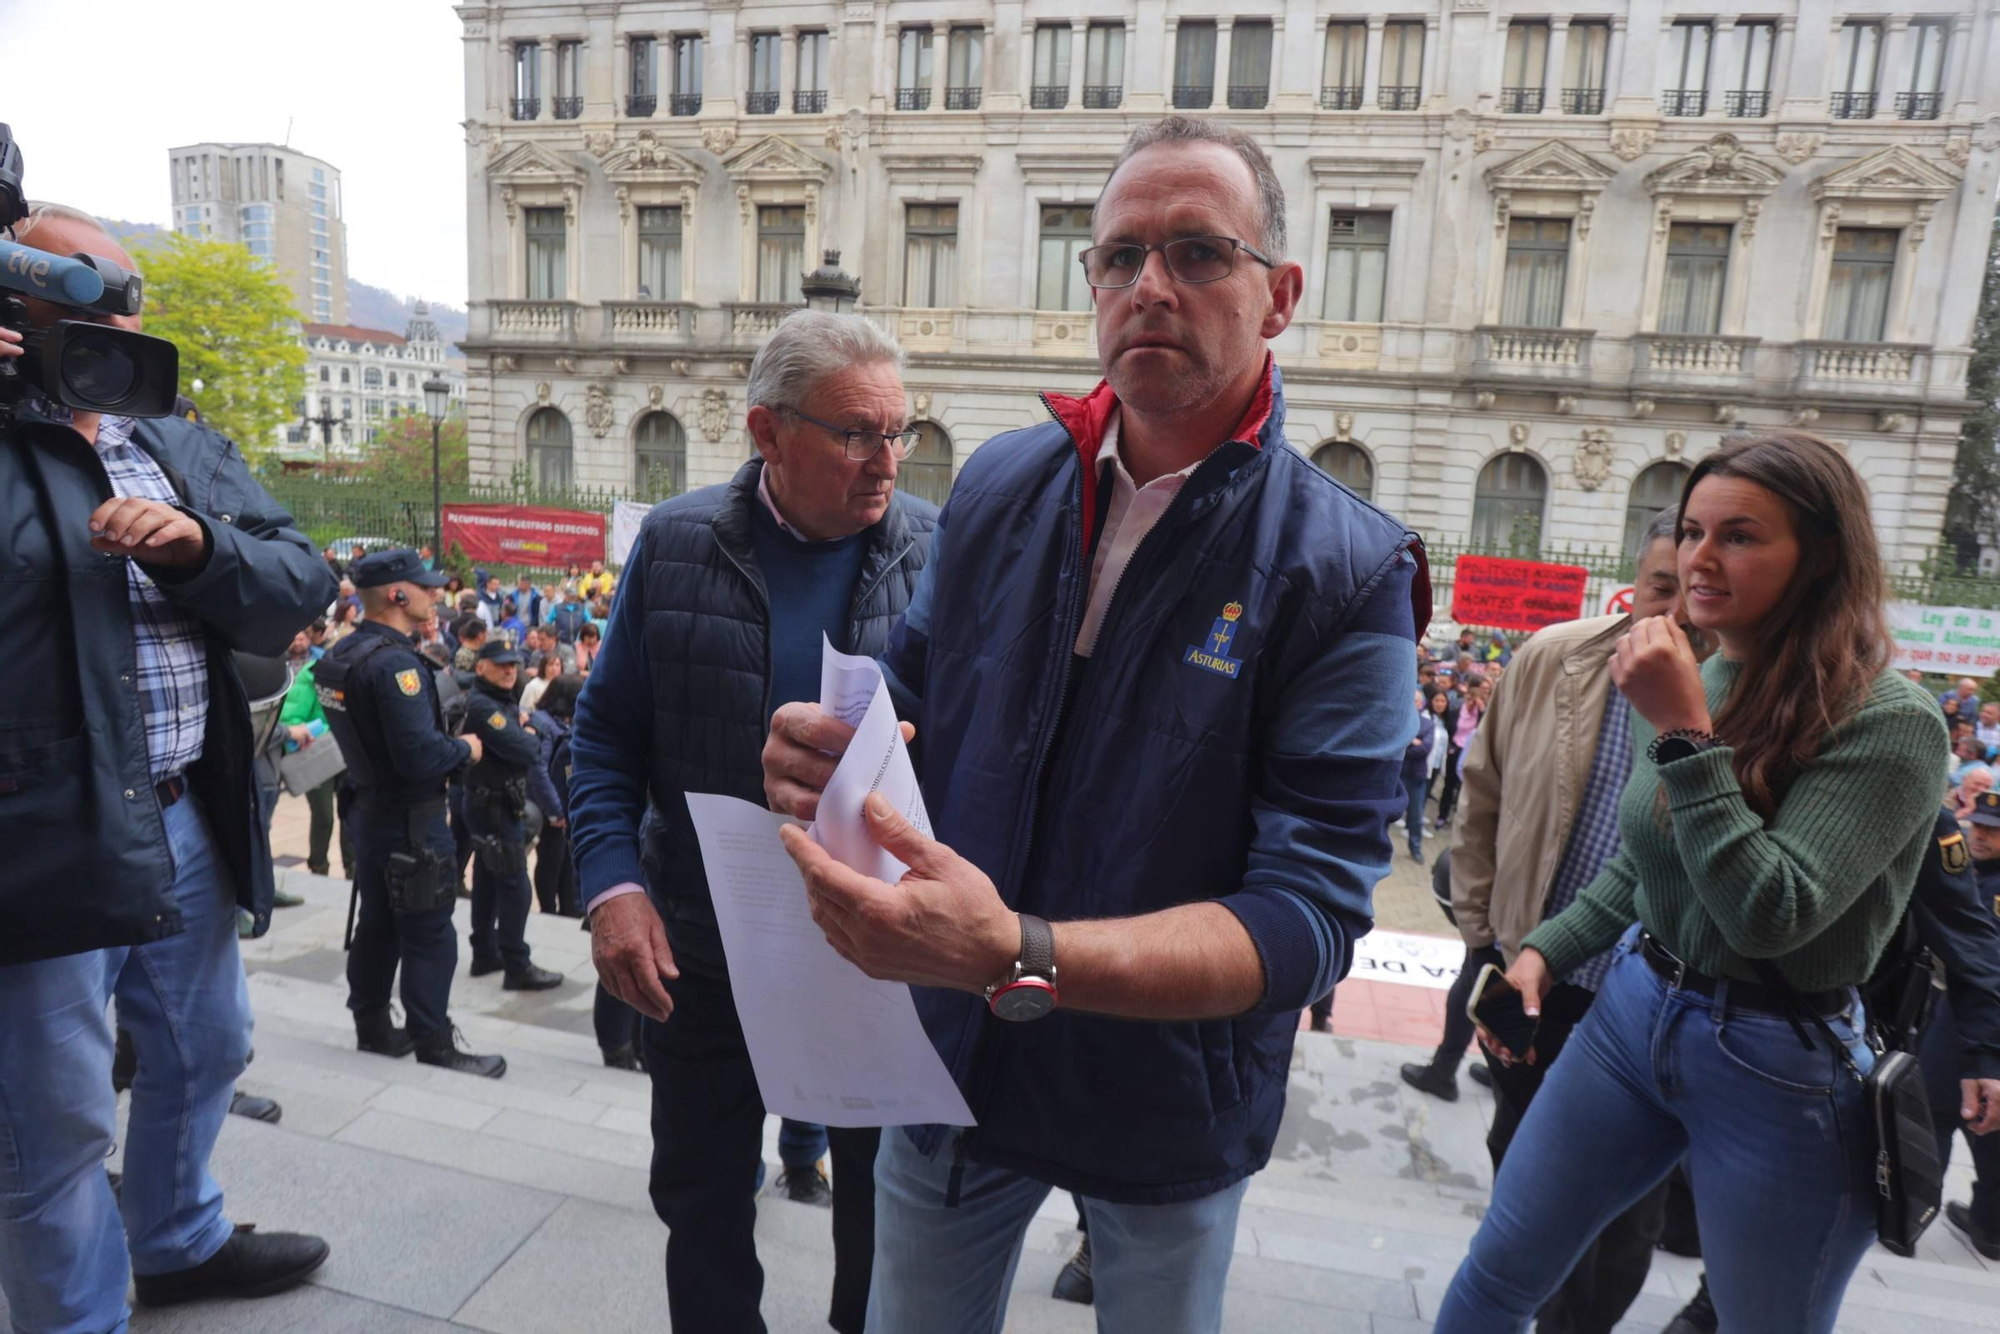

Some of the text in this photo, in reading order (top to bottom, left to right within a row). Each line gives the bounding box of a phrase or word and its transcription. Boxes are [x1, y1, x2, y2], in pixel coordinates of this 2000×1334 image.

[8, 249, 51, 288] tve
[448, 512, 600, 537] RECUPEREMOS NUESTROS DERECHOS
[1921, 610, 1991, 629] Ley de la
[1188, 649, 1236, 674] ASTURIAS
[1910, 648, 1934, 662] que
[1937, 650, 1952, 663] no
[1956, 652, 1970, 665] se
[1355, 956, 1407, 973] DE
